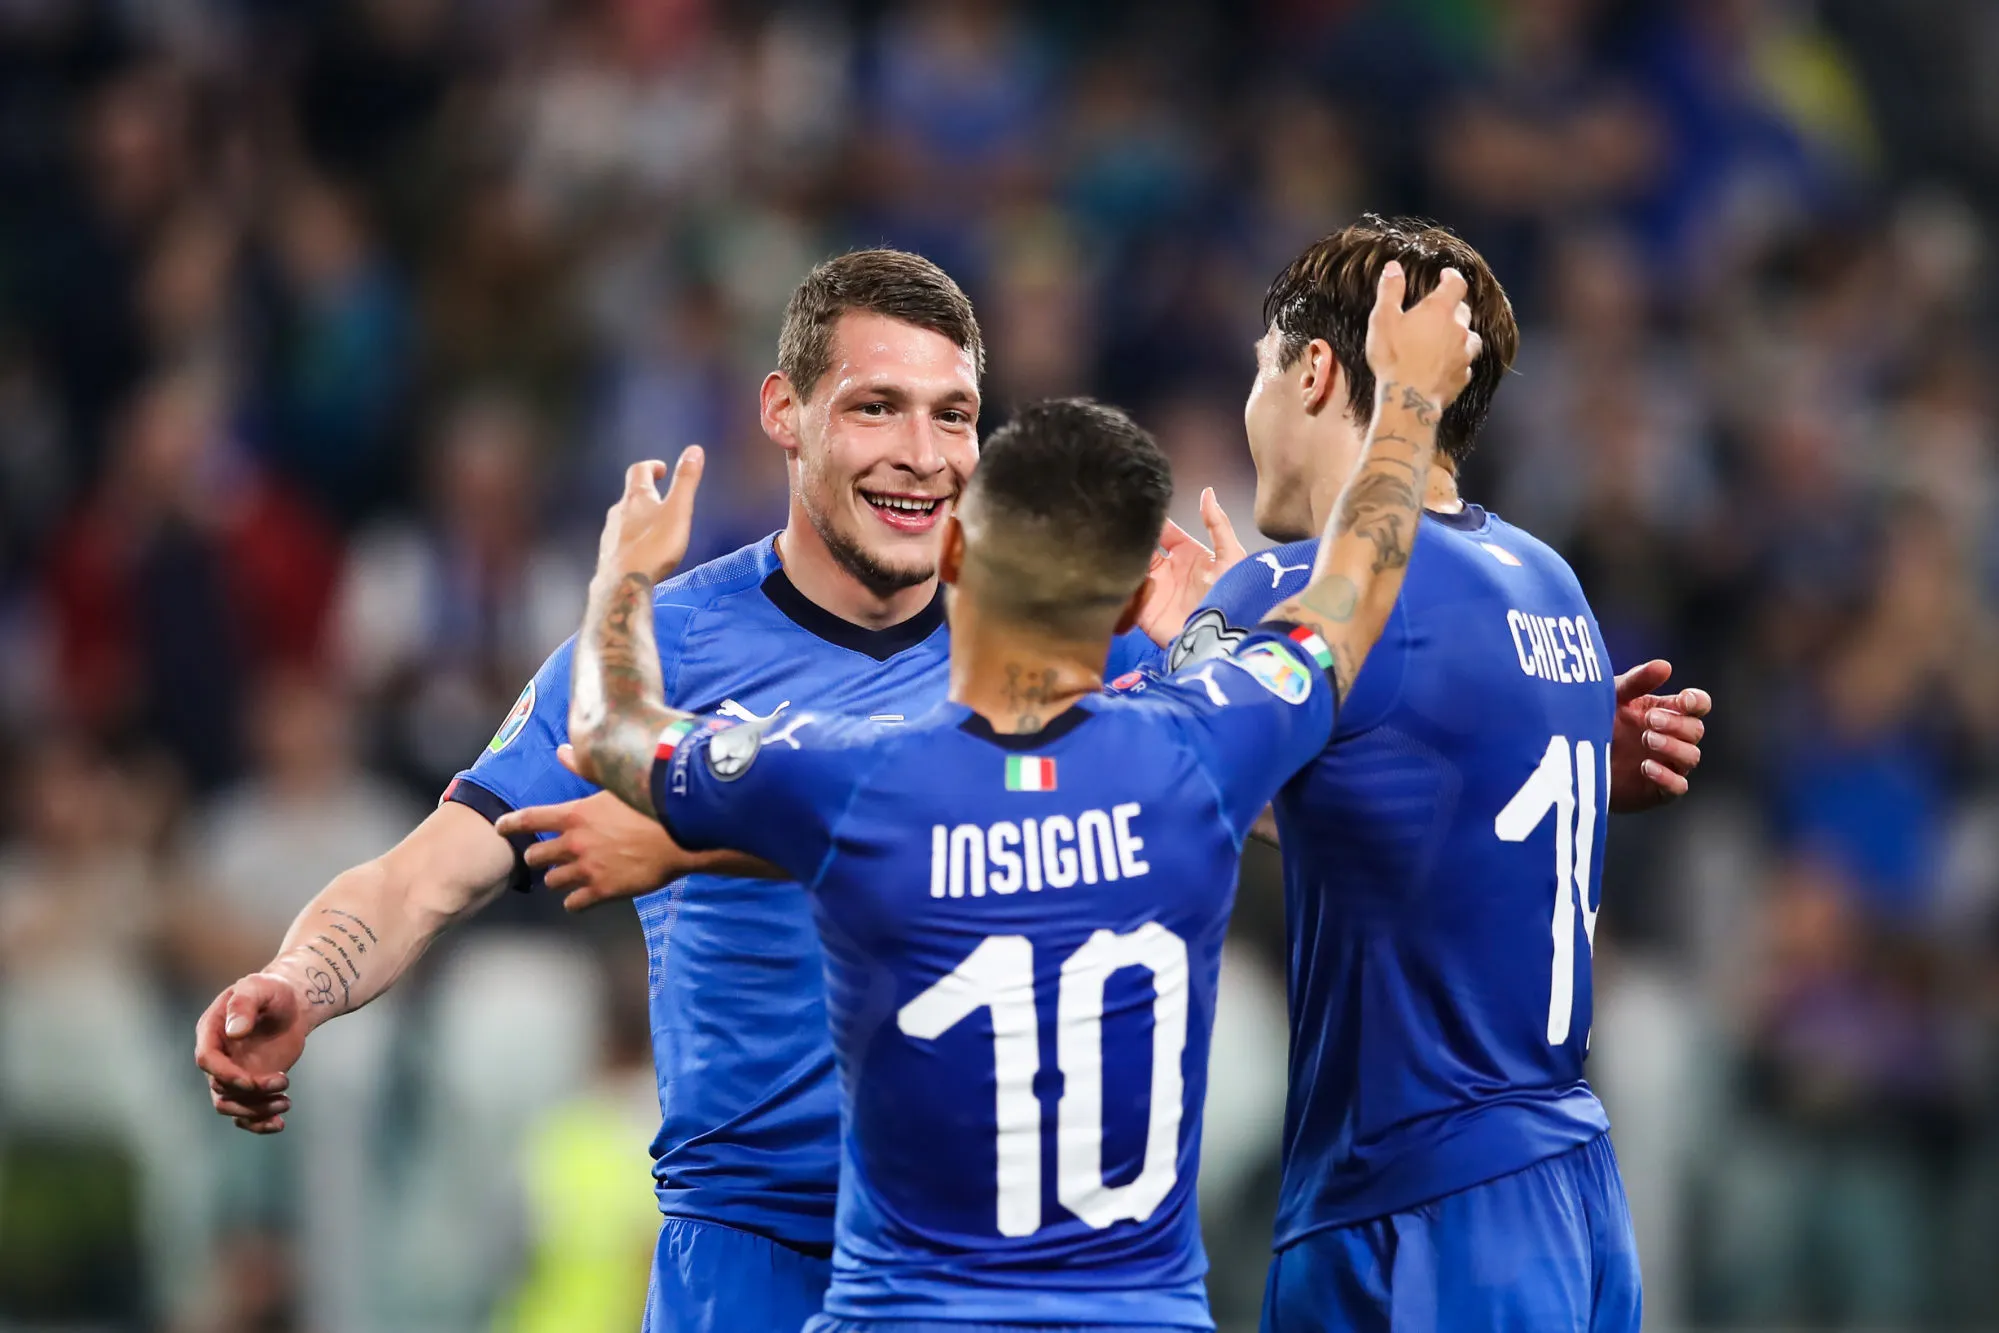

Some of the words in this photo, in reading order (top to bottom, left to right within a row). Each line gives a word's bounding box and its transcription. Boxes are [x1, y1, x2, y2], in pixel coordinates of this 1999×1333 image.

[1506, 609, 1602, 684] CHIESA
[930, 801, 1150, 899] INSIGNE
[897, 920, 1189, 1238] 10
